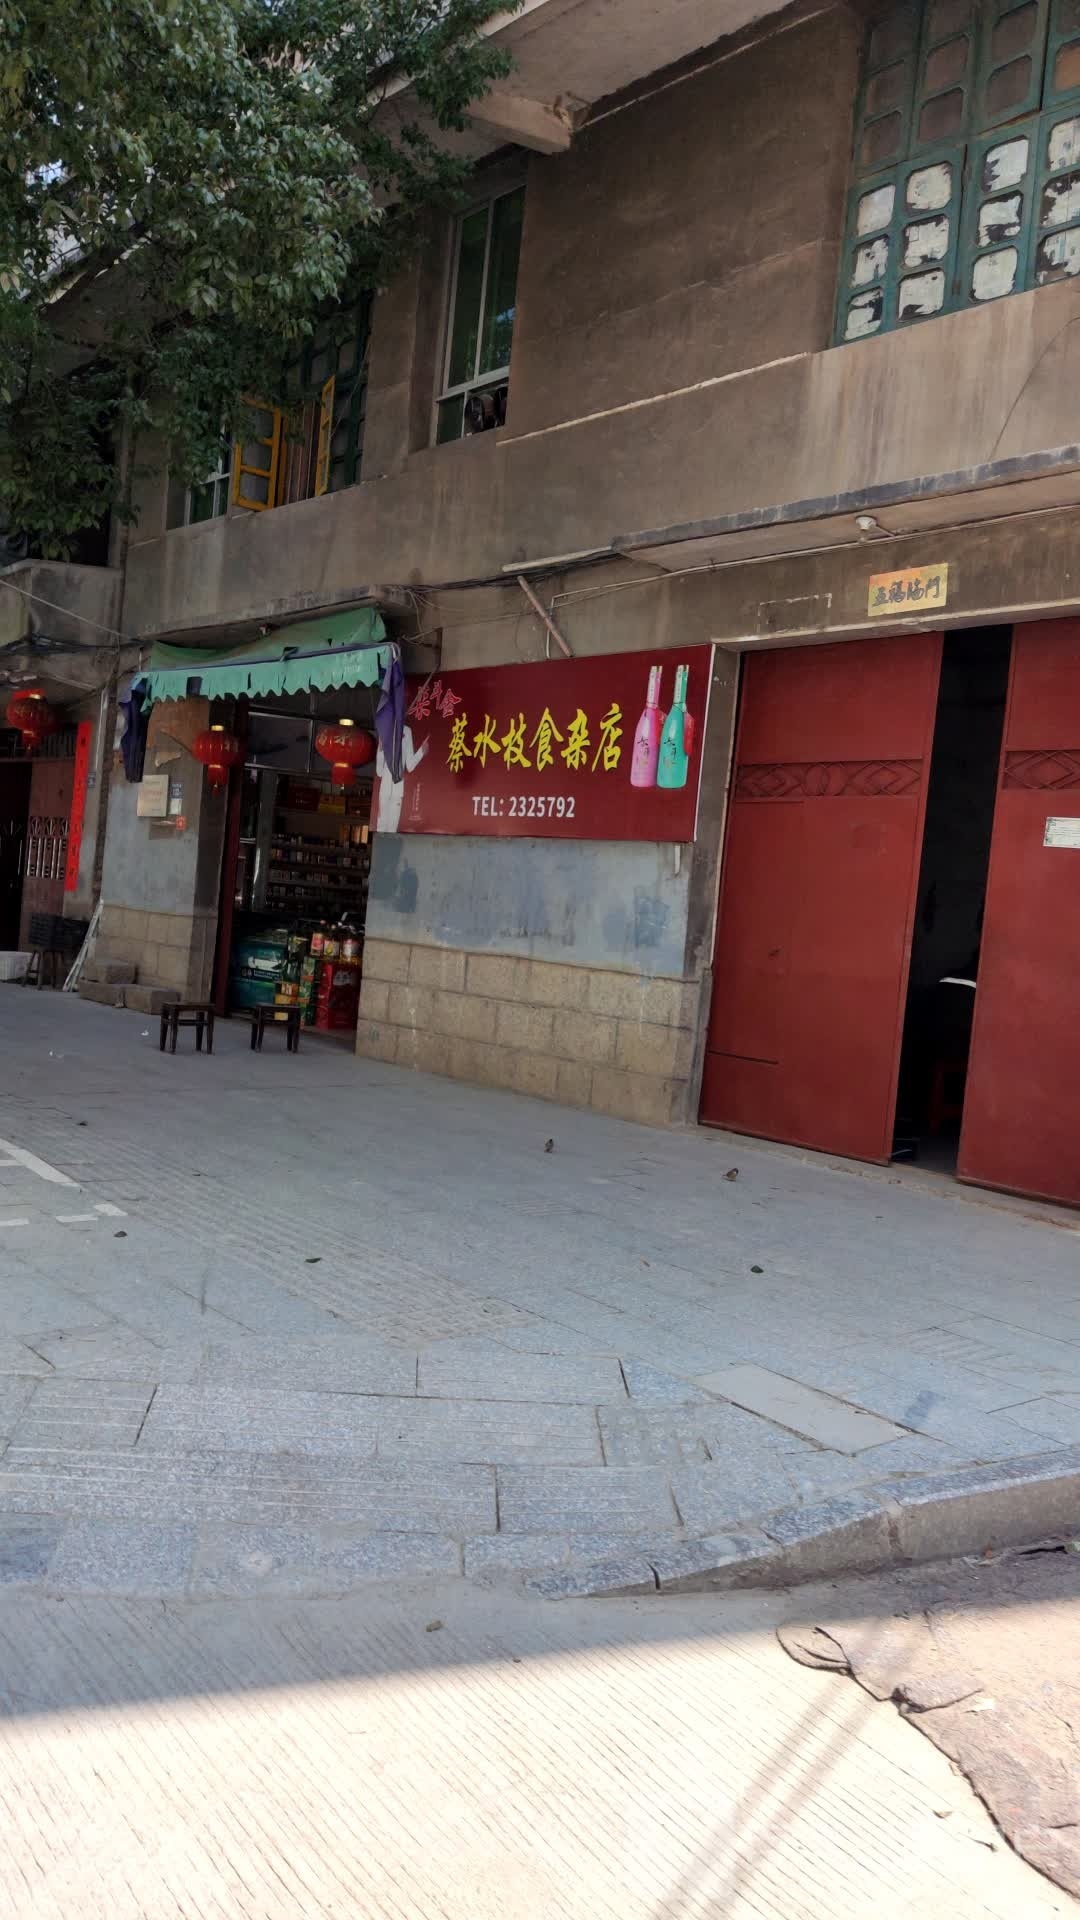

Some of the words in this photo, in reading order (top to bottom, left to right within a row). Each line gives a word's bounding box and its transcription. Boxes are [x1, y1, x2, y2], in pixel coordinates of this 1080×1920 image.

[446, 702, 624, 773] 蔡水枝食杂店
